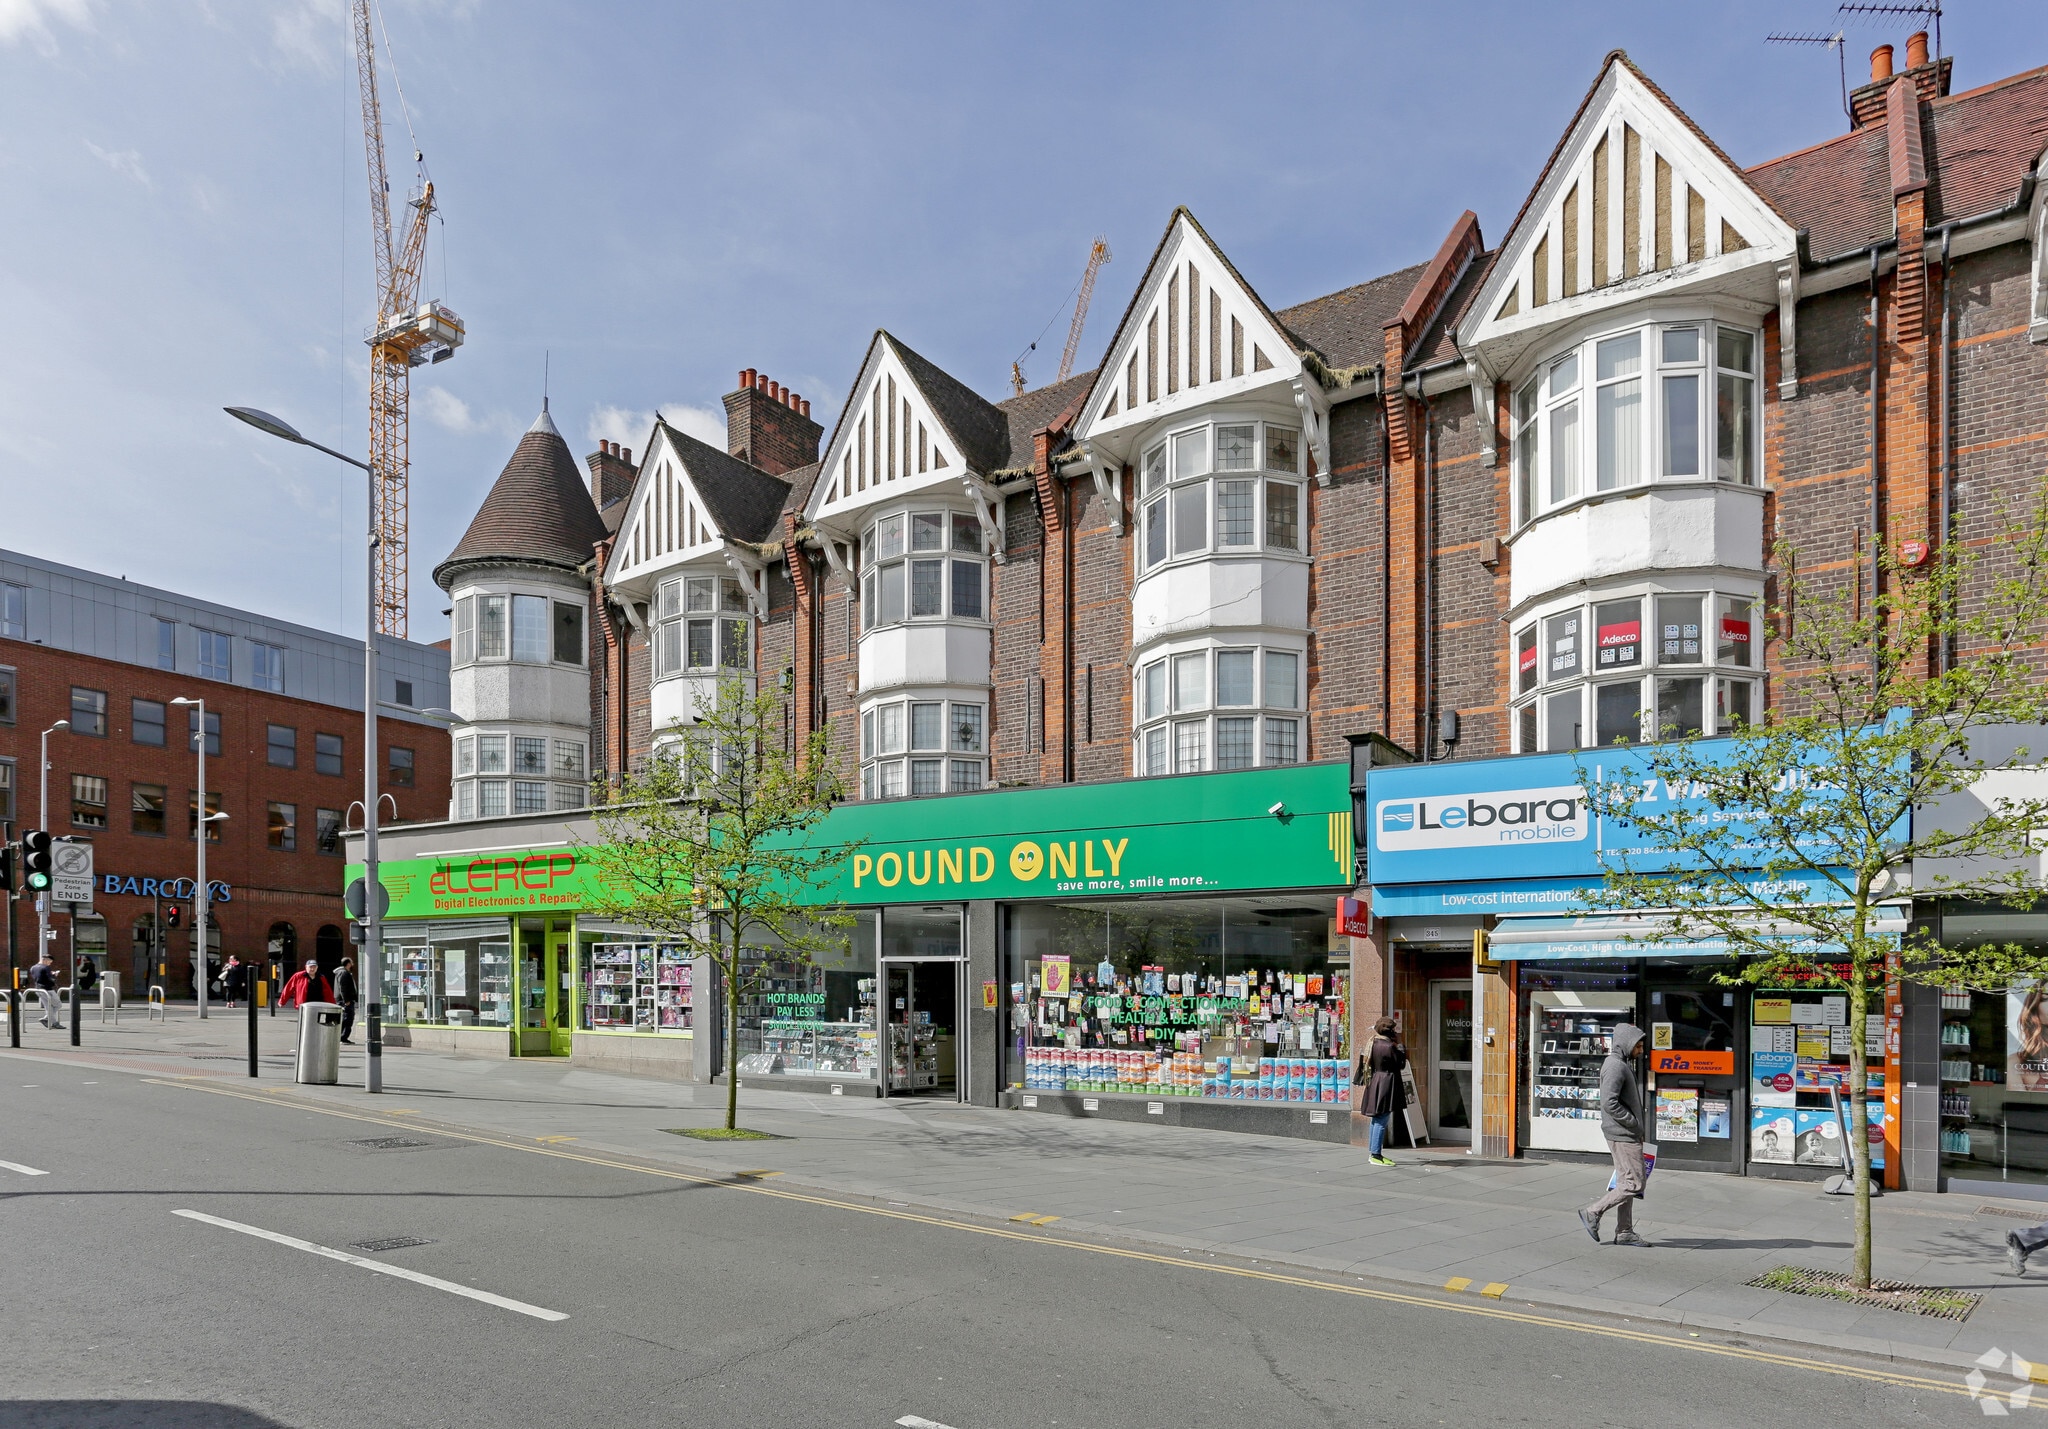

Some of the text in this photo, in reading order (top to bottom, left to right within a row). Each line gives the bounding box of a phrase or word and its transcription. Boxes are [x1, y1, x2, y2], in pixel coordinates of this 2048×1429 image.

[1602, 634, 1636, 645] Adecco
[1721, 630, 1748, 641] Adecco
[1420, 799, 1576, 829] Lebara
[1500, 825, 1575, 841] mobile
[854, 846, 995, 888] POUND
[1057, 874, 1218, 892] save more, smile more...
[58, 892, 88, 900] ENDS
[1442, 894, 1497, 906] Low-cost
[1753, 879, 1807, 894] Mobile
[435, 897, 465, 910] Digital
[468, 895, 525, 907] Electronics
[529, 894, 536, 904] &
[1345, 917, 1366, 934] Adecco
[1548, 944, 1590, 953] Low-Cost,
[1592, 944, 1612, 952] High
[767, 993, 824, 1004] HOT BRANDS
[1088, 996, 1246, 1010] FOOD & CONFECTIONARY
[777, 1006, 814, 1016] PAY LESS
[1109, 1012, 1223, 1025] HEALTH & BEAUTY
[1446, 1018, 1472, 1027] Welco
[769, 1020, 824, 1031] SMILE MORE
[1154, 1028, 1175, 1040] DIY
[1660, 1054, 1690, 1070] Ria
[1755, 1053, 1792, 1062] Lebara
